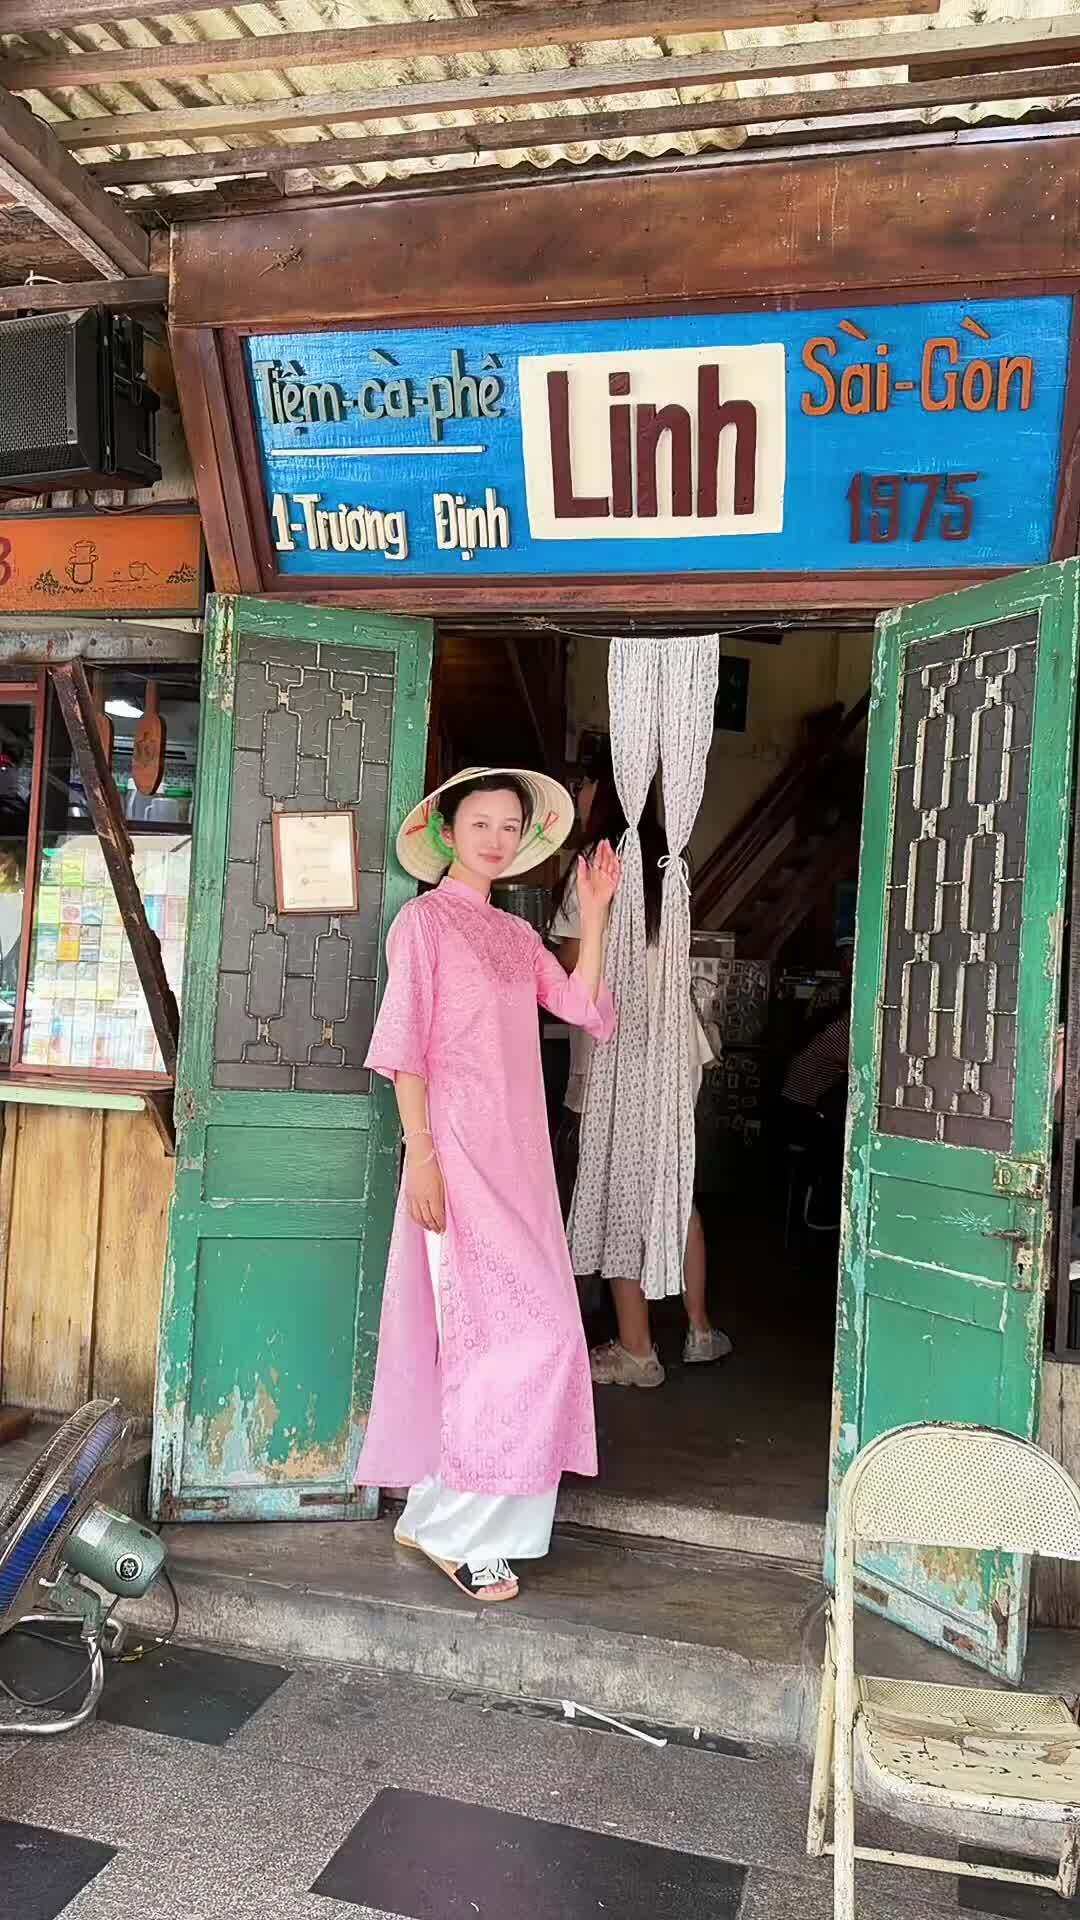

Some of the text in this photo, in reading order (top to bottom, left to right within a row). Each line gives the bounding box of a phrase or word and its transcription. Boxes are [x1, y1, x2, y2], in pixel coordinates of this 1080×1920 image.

[801, 317, 1033, 416] Sài-Gòn
[547, 364, 757, 518] Linh
[272, 488, 511, 561] 1-Trương Định
[848, 471, 978, 544] 1975
